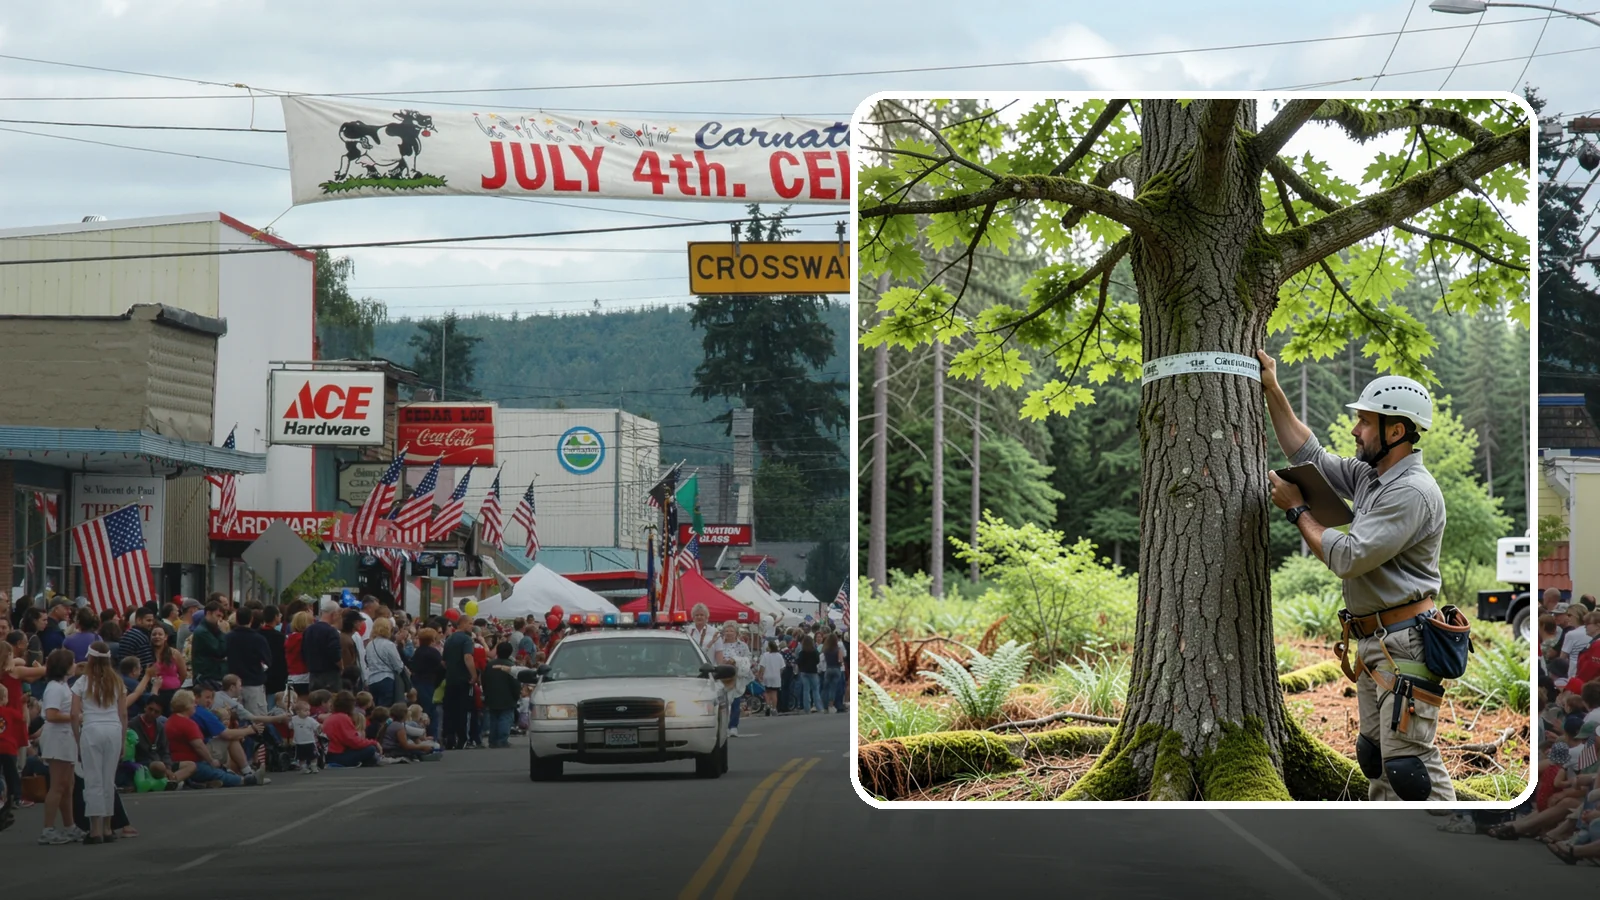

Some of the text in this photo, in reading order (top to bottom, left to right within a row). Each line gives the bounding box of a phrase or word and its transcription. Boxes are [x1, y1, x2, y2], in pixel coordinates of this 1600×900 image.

[695, 121, 850, 150] Carnat
[481, 141, 605, 193] JULY
[632, 150, 746, 198] 4th.
[697, 254, 850, 280] CROSSWA
[282, 380, 374, 420] ACE
[405, 409, 486, 423] CEDAR LOG
[283, 421, 371, 437] Hardware
[416, 428, 477, 447] Coca-Cola
[354, 466, 386, 479] Simpl
[83, 484, 155, 496] St. Vincent de Paul
[699, 535, 730, 544] GLASS
